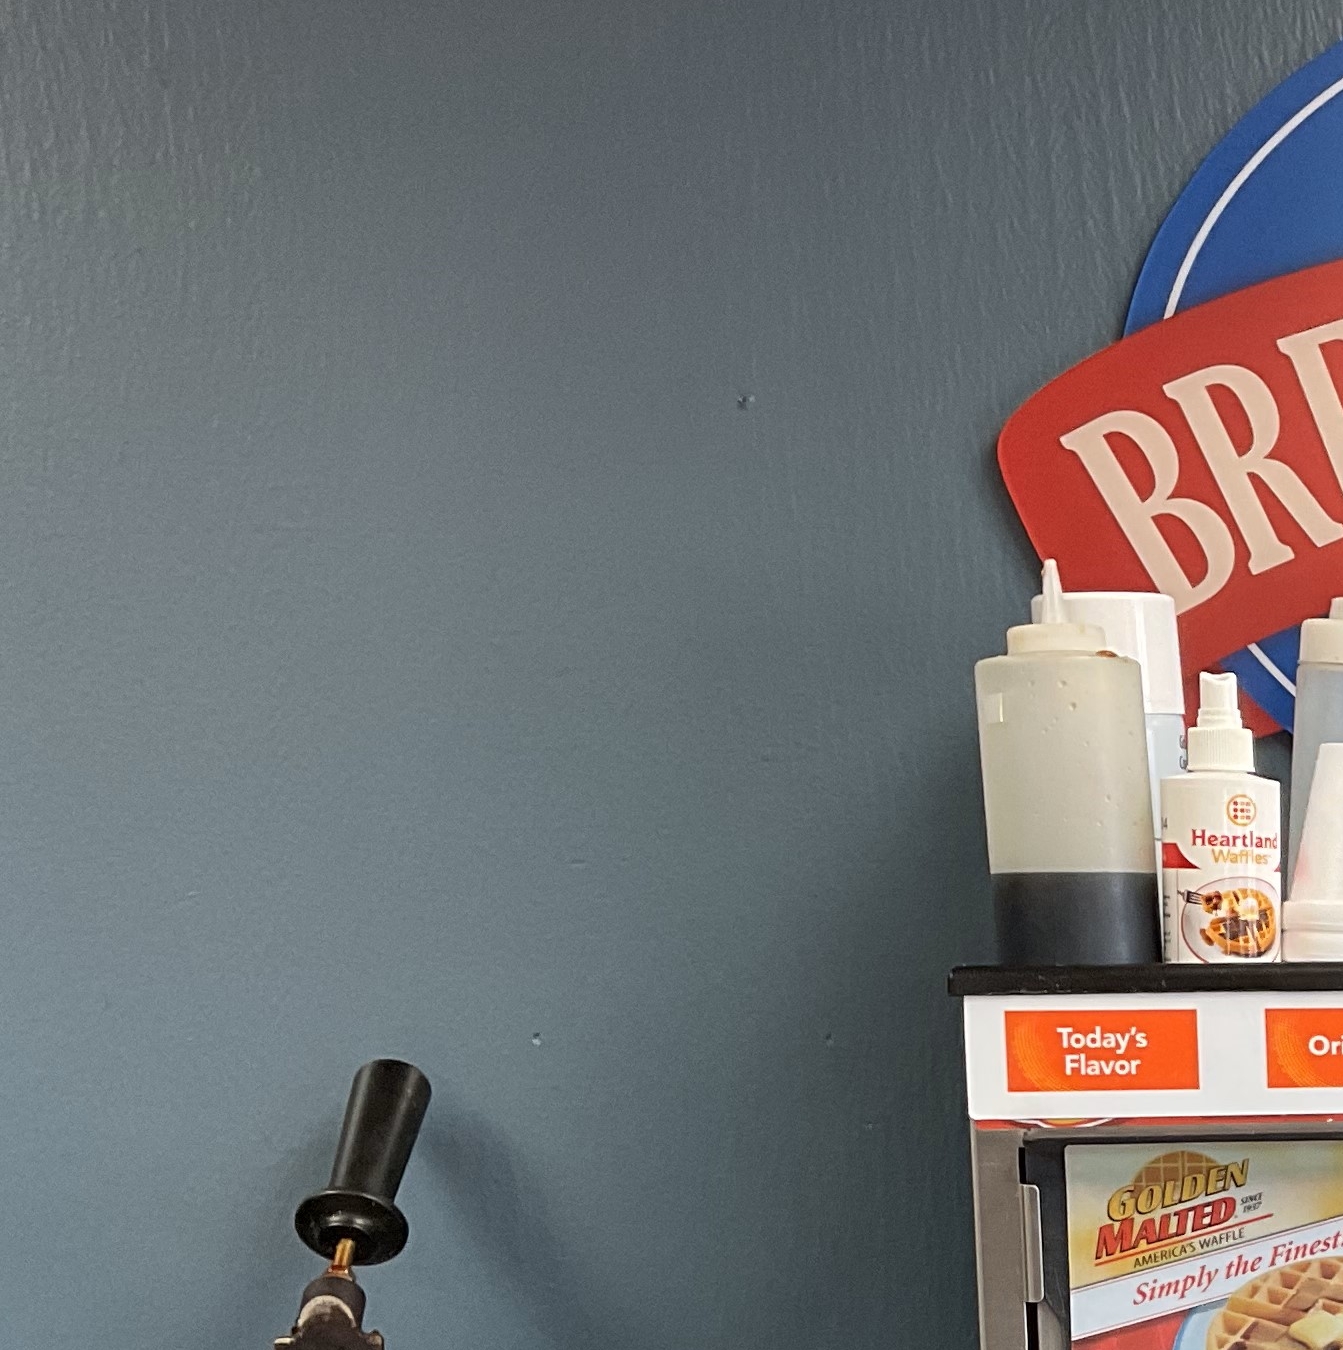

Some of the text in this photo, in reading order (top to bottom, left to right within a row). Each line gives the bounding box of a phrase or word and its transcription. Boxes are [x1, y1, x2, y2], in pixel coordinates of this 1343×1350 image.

[1191, 828, 1278, 849] Heartland
[1211, 849, 1270, 865] Waffles
[1056, 1026, 1149, 1053] Today's
[1064, 1054, 1142, 1077] Flavor
[1107, 1158, 1250, 1222] GOLDEN
[1094, 1196, 1237, 1260] MALTED
[1133, 1226, 1246, 1269] AMERICA'S WAFFLE
[1132, 1264, 1219, 1306] Simply
[1224, 1253, 1261, 1280] the
